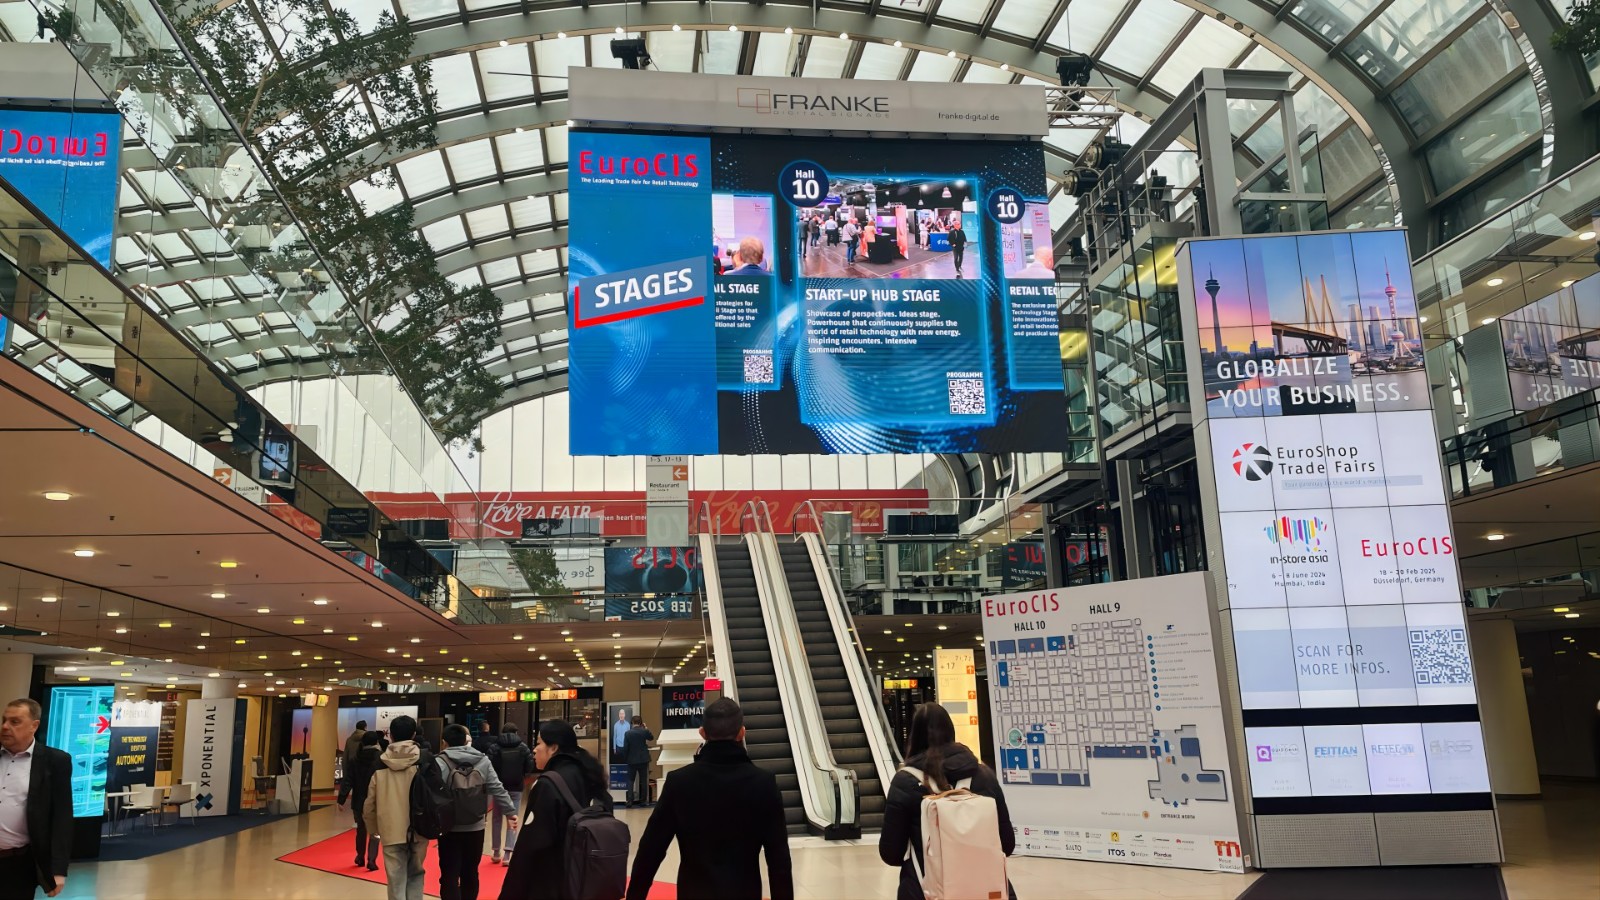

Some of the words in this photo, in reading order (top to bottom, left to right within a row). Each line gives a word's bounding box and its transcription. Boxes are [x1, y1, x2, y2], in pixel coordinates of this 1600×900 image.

[773, 94, 889, 113] FRANKE
[580, 150, 699, 178] EuroCIS
[795, 169, 815, 179] Hall
[592, 177, 614, 185] Leading
[792, 180, 820, 200] 10
[997, 202, 1019, 218] 10
[594, 267, 693, 308] STAGES
[728, 283, 760, 294] STAGE
[1009, 286, 1040, 296] RETAIL
[805, 288, 867, 301] START-UP
[871, 289, 899, 301] HUB
[902, 290, 941, 301] STAGE
[806, 309, 841, 318] Showcase
[842, 309, 850, 317] of
[851, 310, 897, 319] perspectives.
[919, 311, 941, 319] stage.
[868, 319, 913, 328] continuously
[915, 320, 944, 328] supplies
[860, 328, 899, 337] technology
[808, 337, 840, 346] Inspiring
[808, 346, 866, 354] communication.
[1216, 357, 1339, 380] GLOBALIZE
[1217, 387, 1282, 408] YOUR
[1290, 382, 1411, 406] BUSINESS.
[1276, 445, 1360, 460] EuroShop
[1278, 462, 1327, 476] Trade
[1334, 460, 1376, 474] Fairs
[1361, 536, 1453, 557] EuroCIS
[1270, 555, 1306, 564] in-store
[985, 593, 1060, 617] EuroCIS
[1089, 604, 1112, 614] HALL
[1114, 602, 1121, 612] 9
[1014, 621, 1034, 632] HALL
[1036, 620, 1046, 630] 10
[1297, 645, 1331, 658] SCAN
[1337, 644, 1364, 657] FOR
[1300, 662, 1339, 676] MORE
[1344, 662, 1391, 675] INFOS.
[200, 705, 217, 787] XPONENTIAL
[1314, 746, 1358, 755] FEITIAN
[1107, 848, 1126, 856] ITOS
